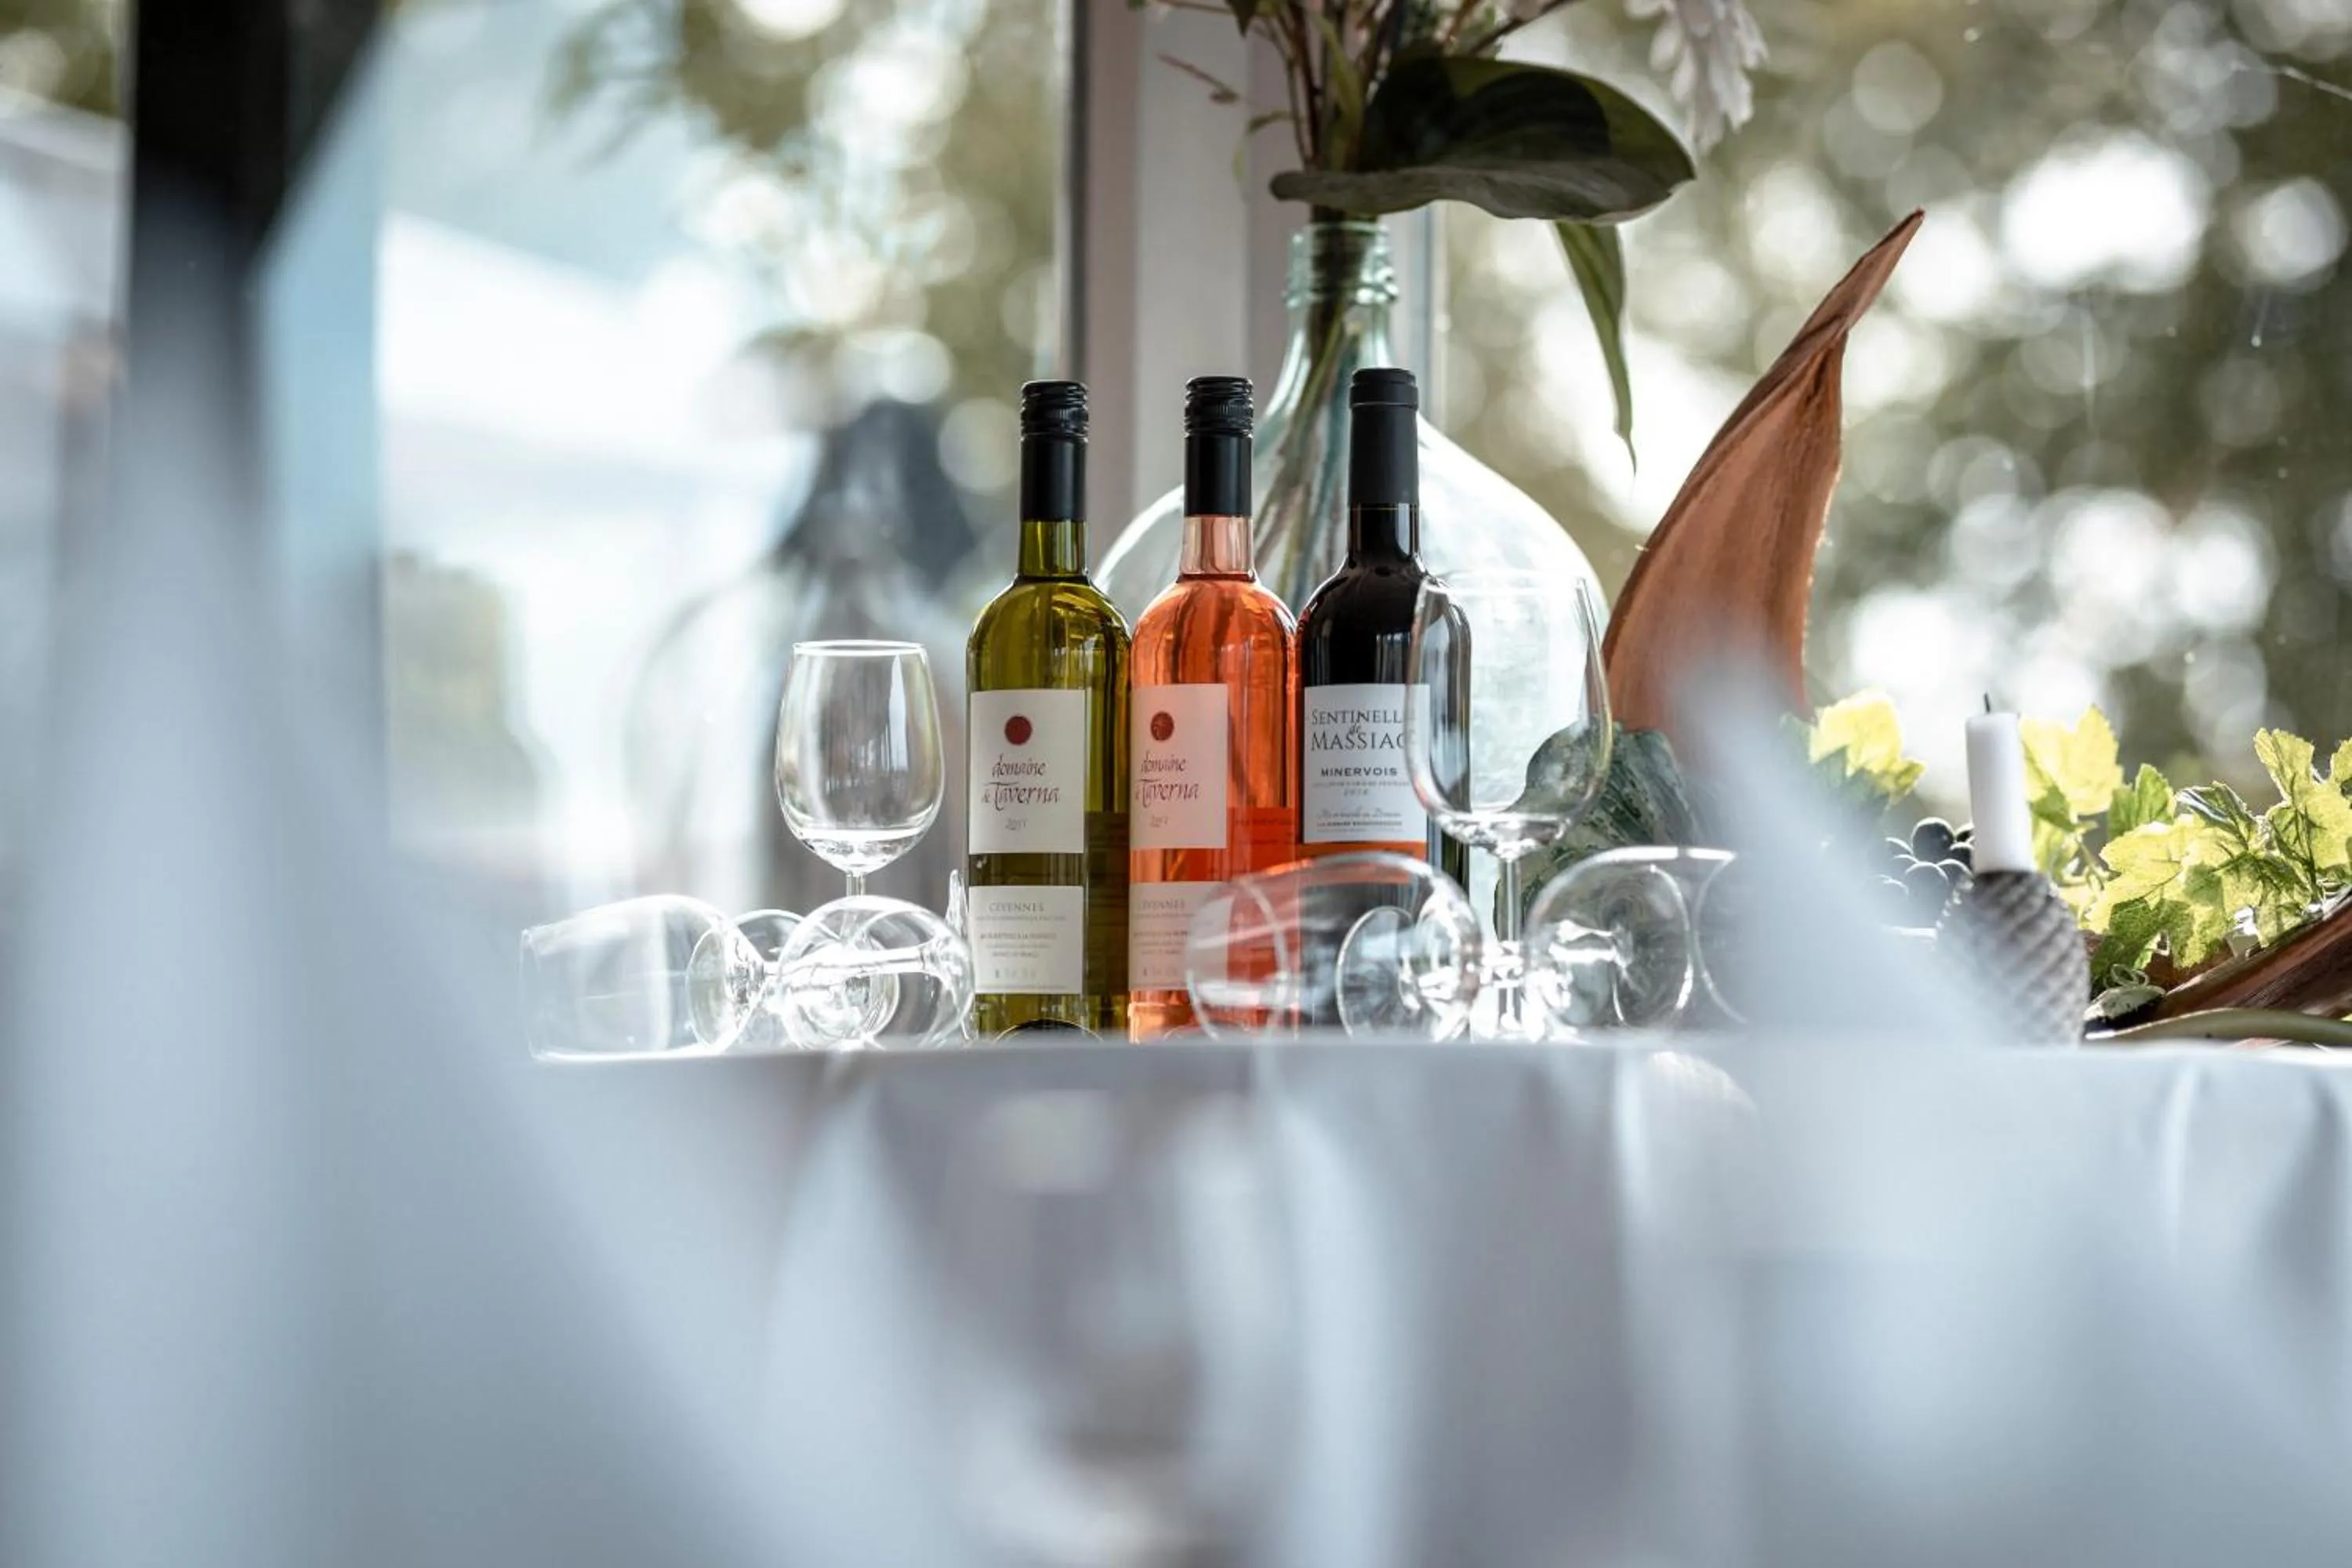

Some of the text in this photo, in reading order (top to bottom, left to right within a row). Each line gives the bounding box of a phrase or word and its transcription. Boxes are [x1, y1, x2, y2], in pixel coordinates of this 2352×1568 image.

[992, 753, 1046, 777] domaine
[1142, 750, 1186, 773] domaine
[1321, 767, 1398, 777] MINERVOIS
[984, 781, 1061, 811] Taverna
[1139, 779, 1200, 808] Taverna
